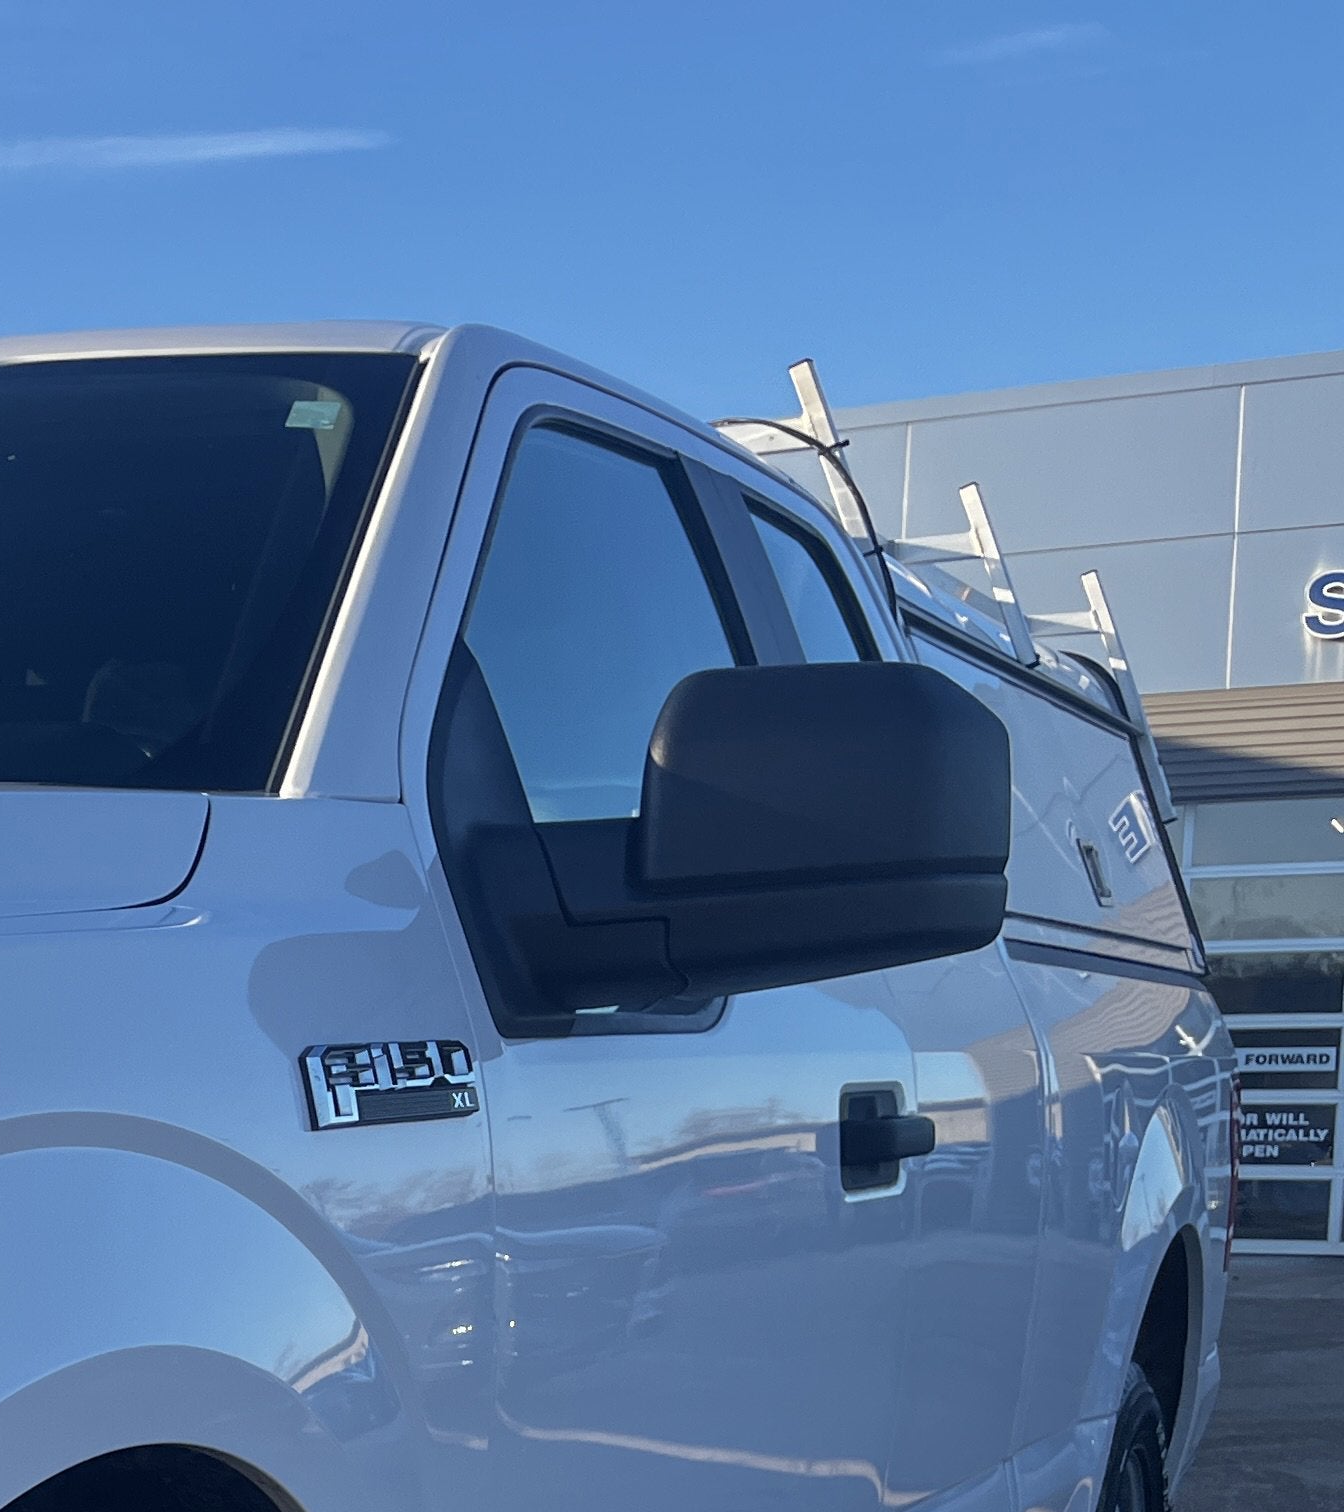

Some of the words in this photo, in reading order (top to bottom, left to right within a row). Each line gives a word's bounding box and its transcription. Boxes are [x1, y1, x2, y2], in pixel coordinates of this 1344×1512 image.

[1244, 1053, 1331, 1066] FORWARD
[452, 1092, 475, 1109] XL
[1265, 1112, 1310, 1126] WILL
